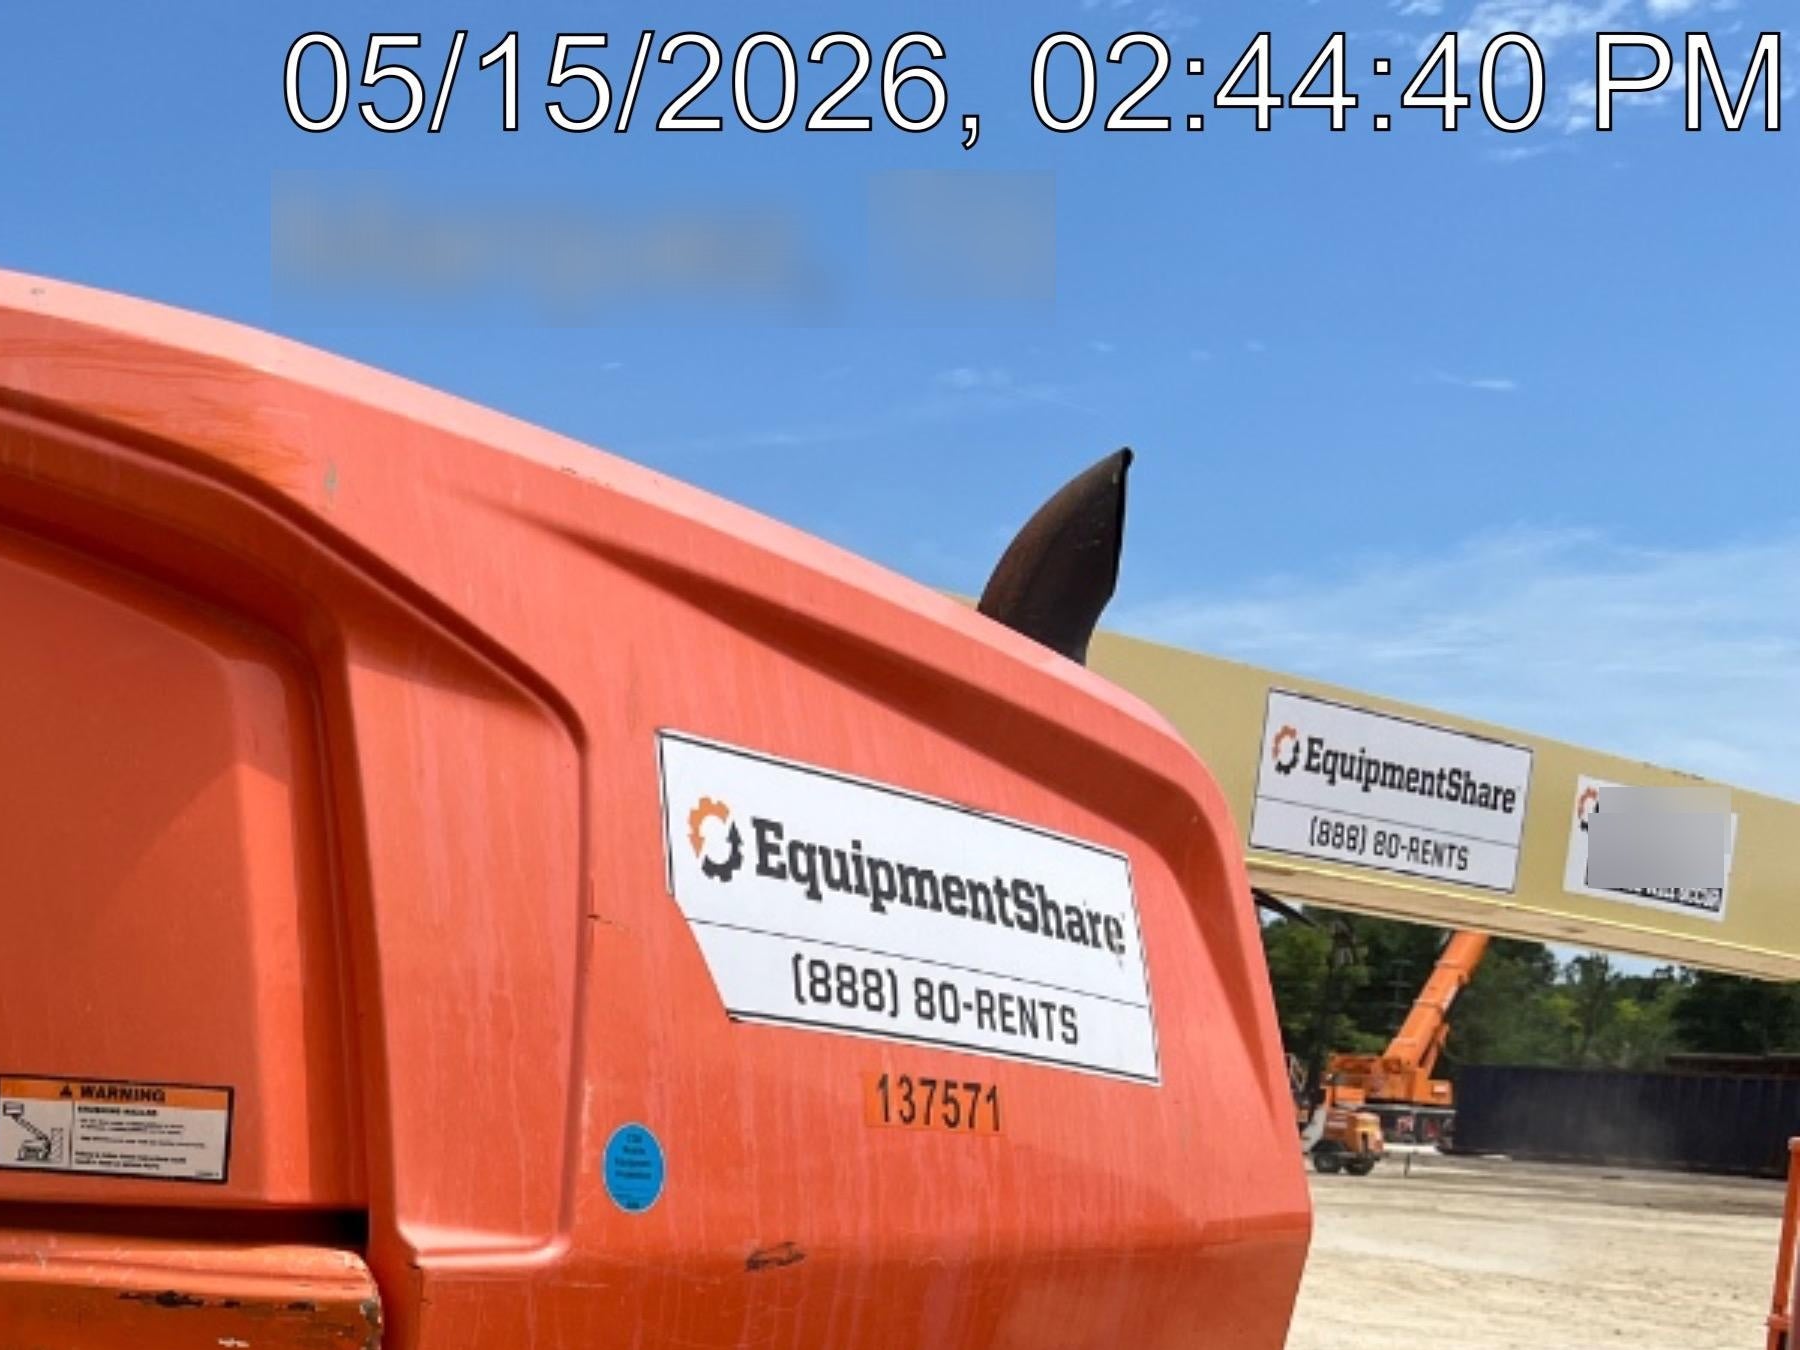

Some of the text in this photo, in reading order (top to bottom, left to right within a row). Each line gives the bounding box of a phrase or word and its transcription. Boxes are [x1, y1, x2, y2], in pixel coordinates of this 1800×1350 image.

[1304, 736, 1516, 814] EquipmentShare
[1310, 815, 1469, 871] (888) 80-RENTS
[751, 816, 1126, 955] EquipmentShare
[792, 952, 1079, 1046] (888) 80-RENTS
[80, 1084, 166, 1103] WARNING
[877, 1073, 1000, 1132] 137571
